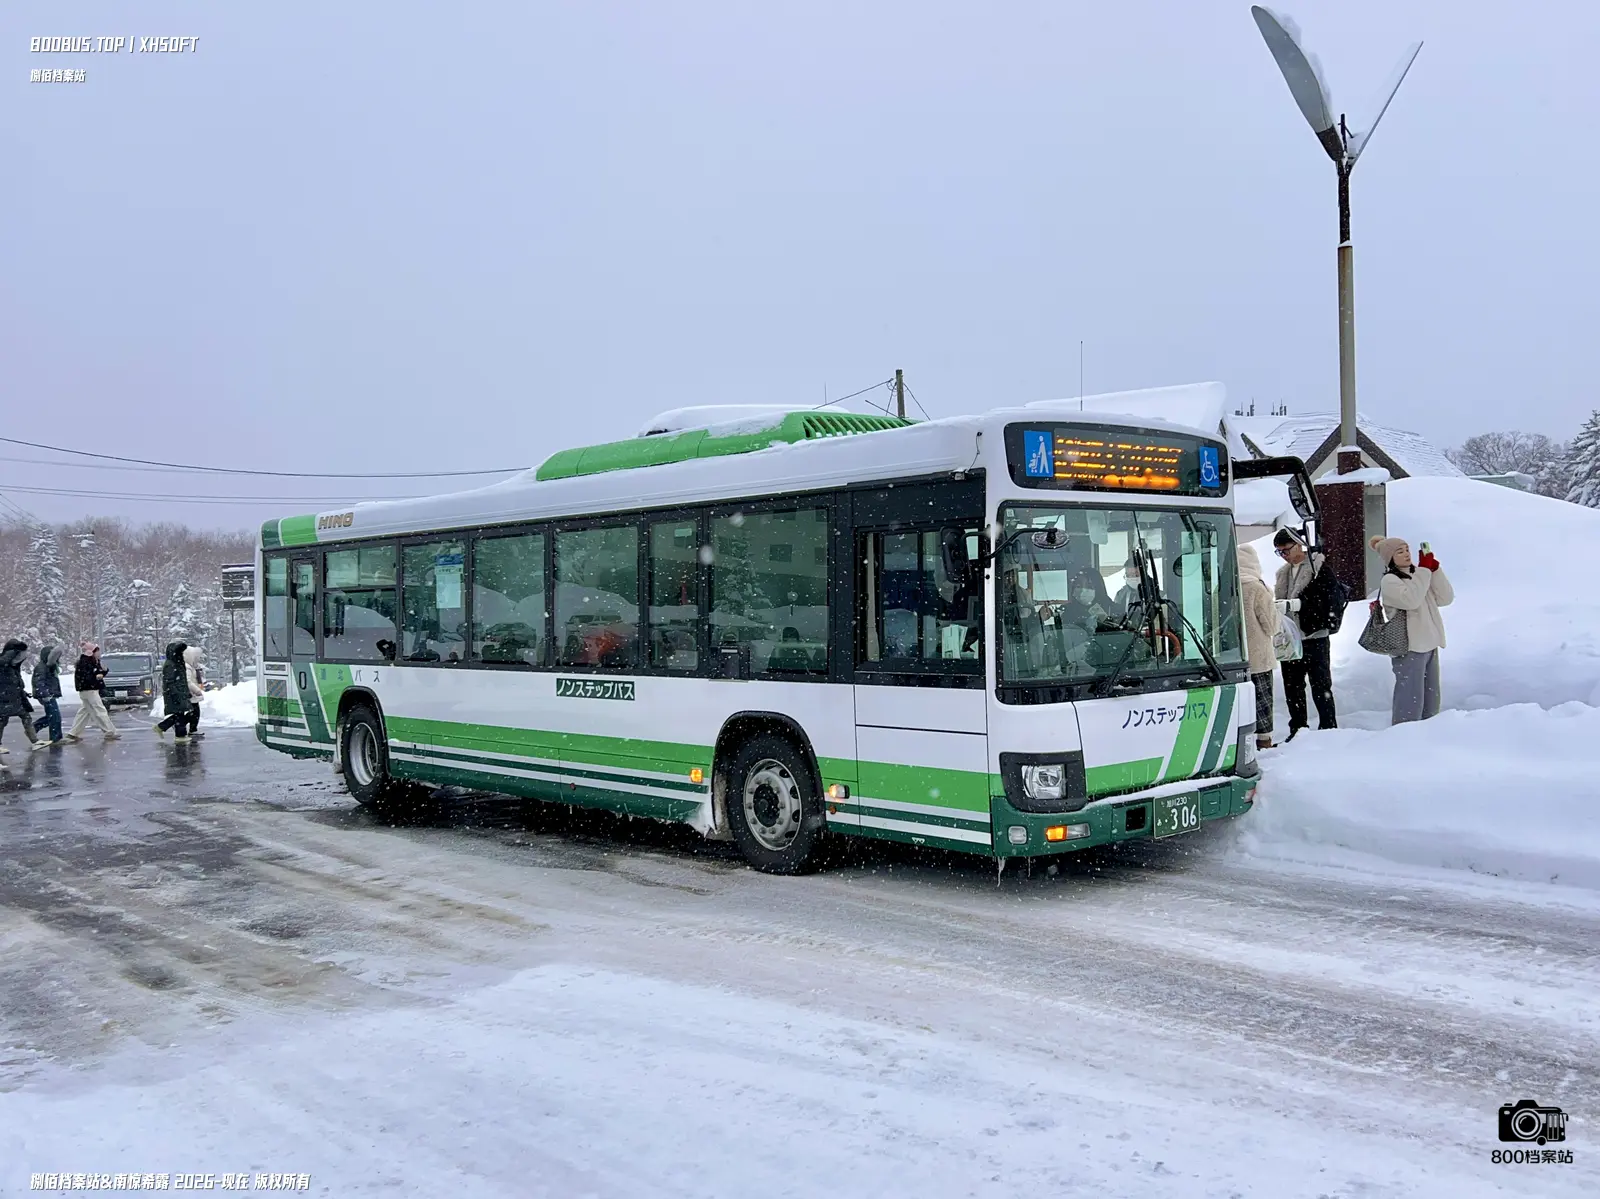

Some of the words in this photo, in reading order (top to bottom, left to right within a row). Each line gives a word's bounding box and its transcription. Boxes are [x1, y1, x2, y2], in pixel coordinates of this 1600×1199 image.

[318, 512, 354, 530] HINO
[557, 680, 634, 699] ノンステップバス
[1122, 702, 1208, 729] ノンステップバス
